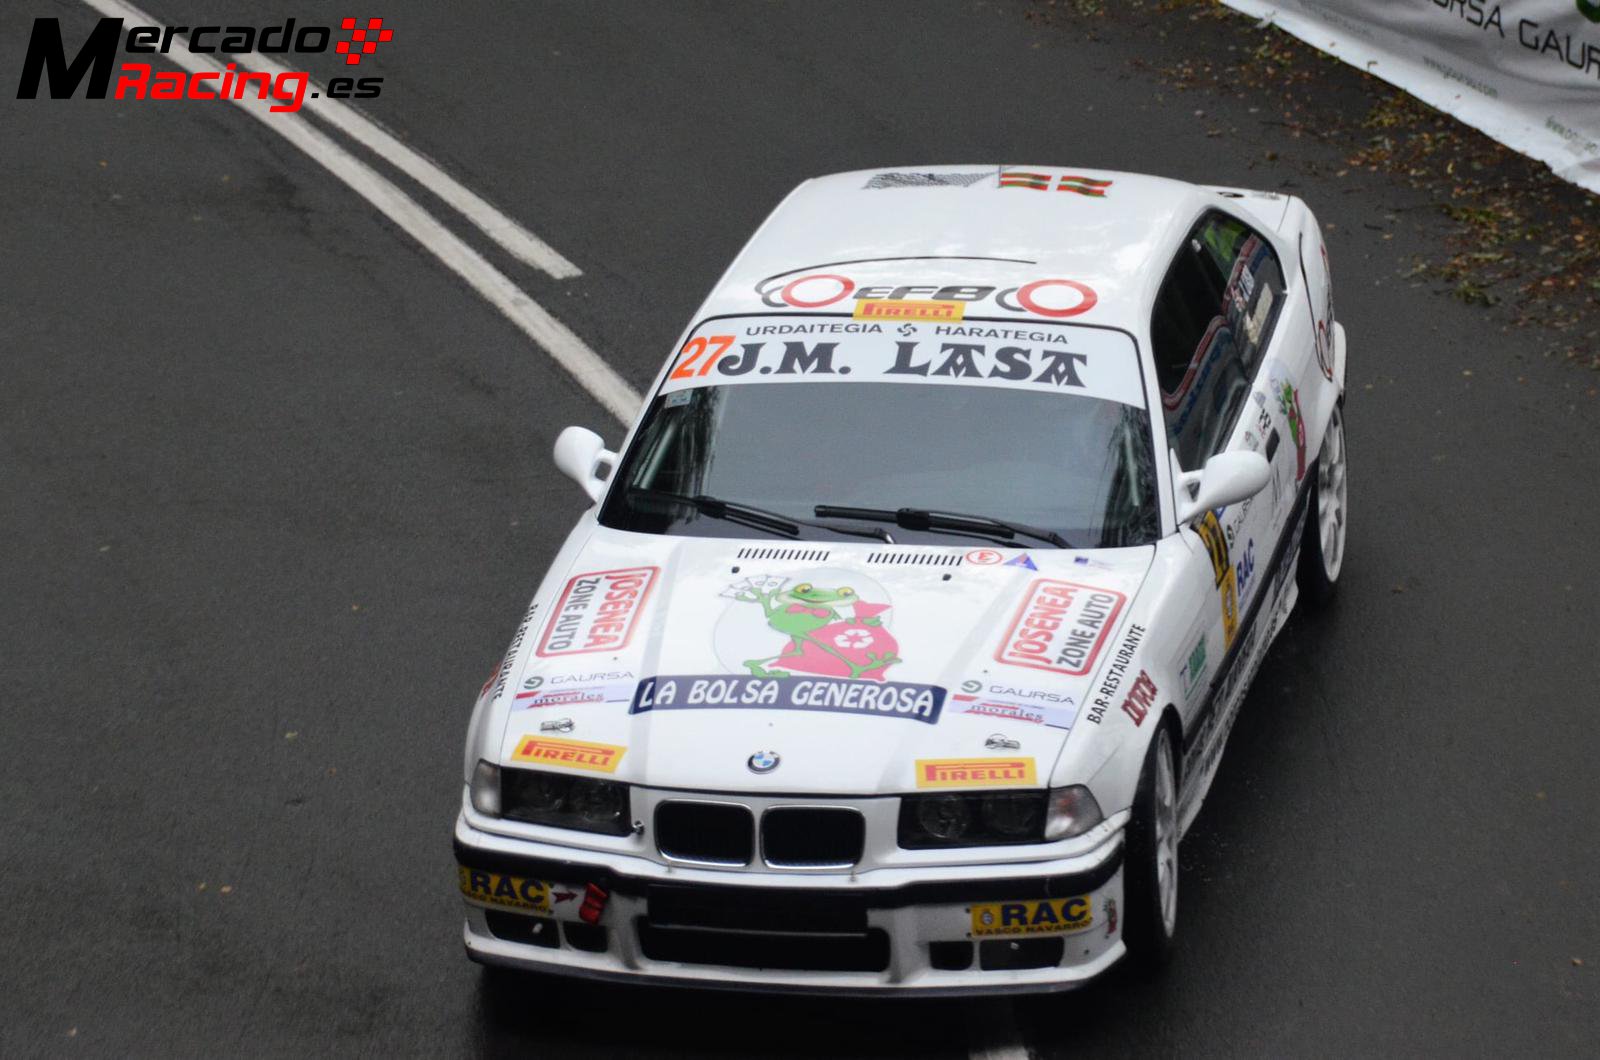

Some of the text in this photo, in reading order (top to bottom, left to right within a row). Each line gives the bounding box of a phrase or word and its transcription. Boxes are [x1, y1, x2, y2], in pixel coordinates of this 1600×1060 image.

[1519, 18, 1600, 80] GAUR
[863, 303, 955, 317] PIRELLI
[746, 323, 1069, 345] URDAITEGIA HARATEGIA
[670, 335, 736, 380] 27
[717, 341, 1088, 388] J.M. LASA
[548, 577, 601, 650] ZONE AUTO
[583, 572, 649, 648] JOSENEA
[1009, 586, 1079, 664] JOSENEA
[1056, 593, 1115, 669] ZONE AUTO
[551, 671, 635, 685] GAURSA
[1087, 623, 1147, 725] BAR-RESTAURANTE
[534, 690, 604, 704] morales
[638, 679, 934, 717] LA BOLSA GENEROSA
[989, 685, 1075, 705] GAURSA
[970, 704, 1043, 720] morales
[521, 739, 616, 767] PIRELLI
[925, 761, 1026, 782] PIRELLI
[470, 870, 545, 904] RAC
[1001, 898, 1088, 926] RAC
[975, 920, 1091, 936] VASCO NAVARRO
